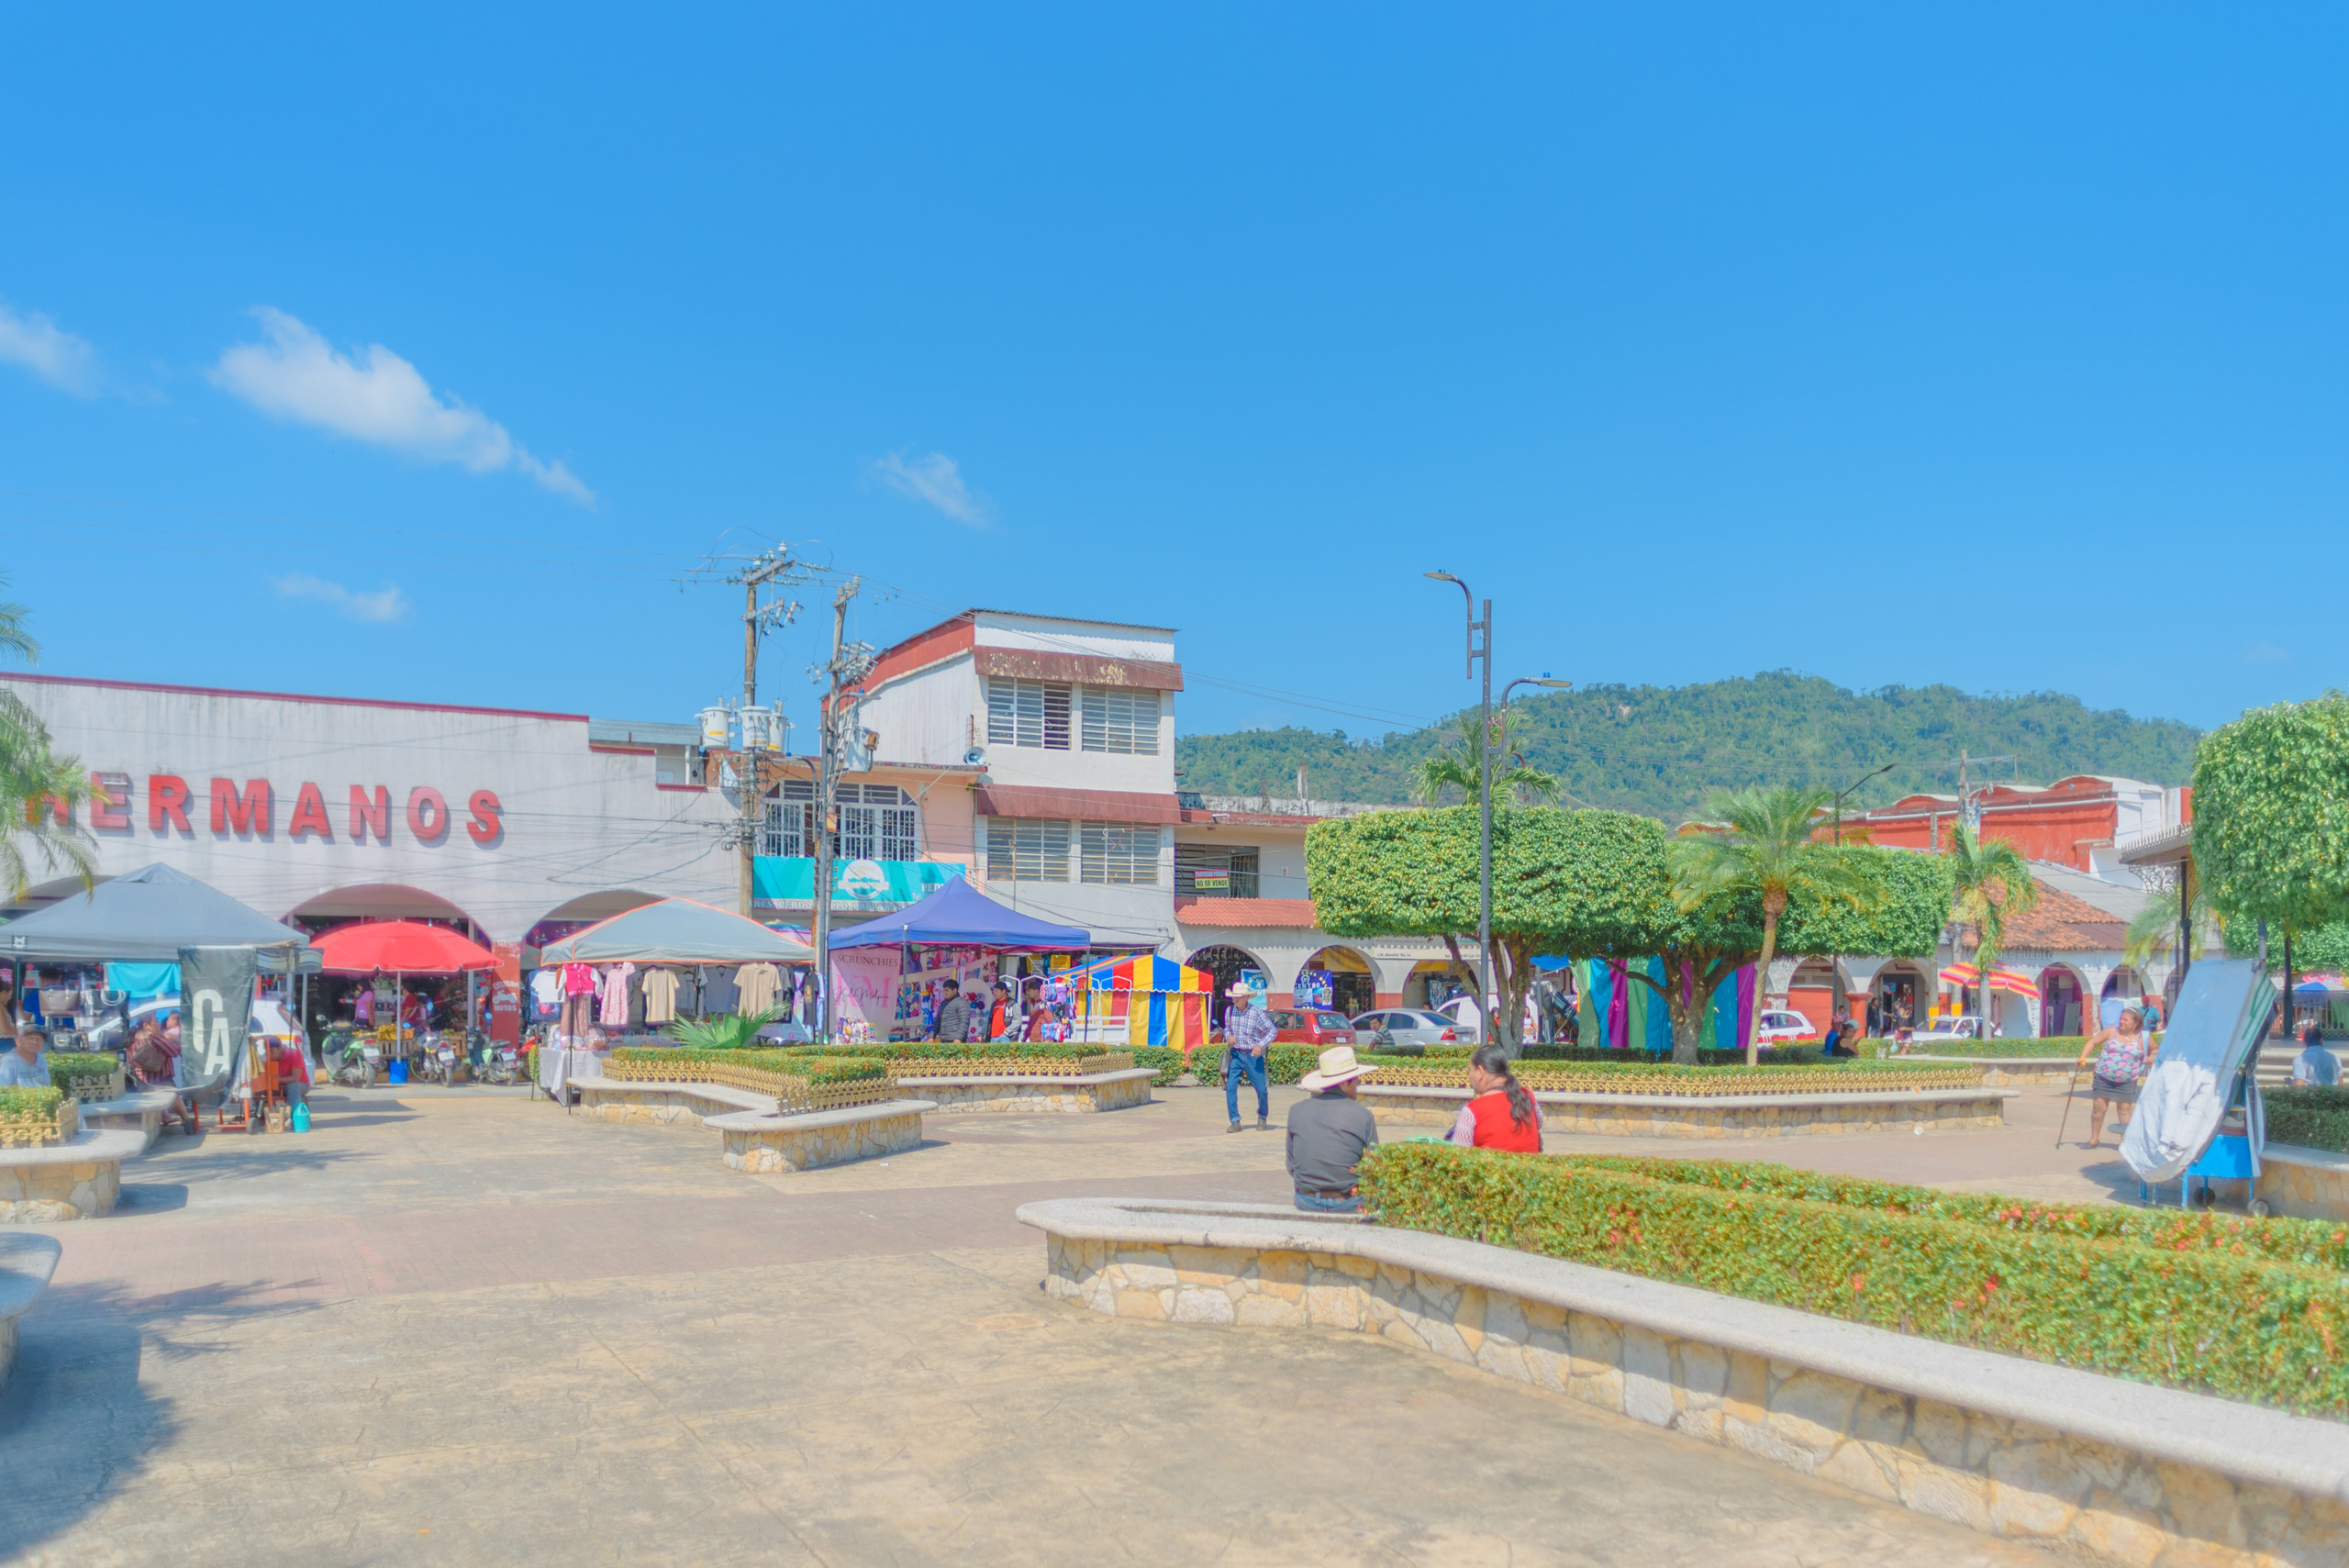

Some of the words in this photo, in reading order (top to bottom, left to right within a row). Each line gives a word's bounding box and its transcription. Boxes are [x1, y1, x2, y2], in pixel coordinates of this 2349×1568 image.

[25, 771, 500, 842] HERMANOS
[921, 883, 944, 892] PED
[837, 954, 898, 967] SCRUNCHIES
[494, 1004, 517, 1012] MOTOS
